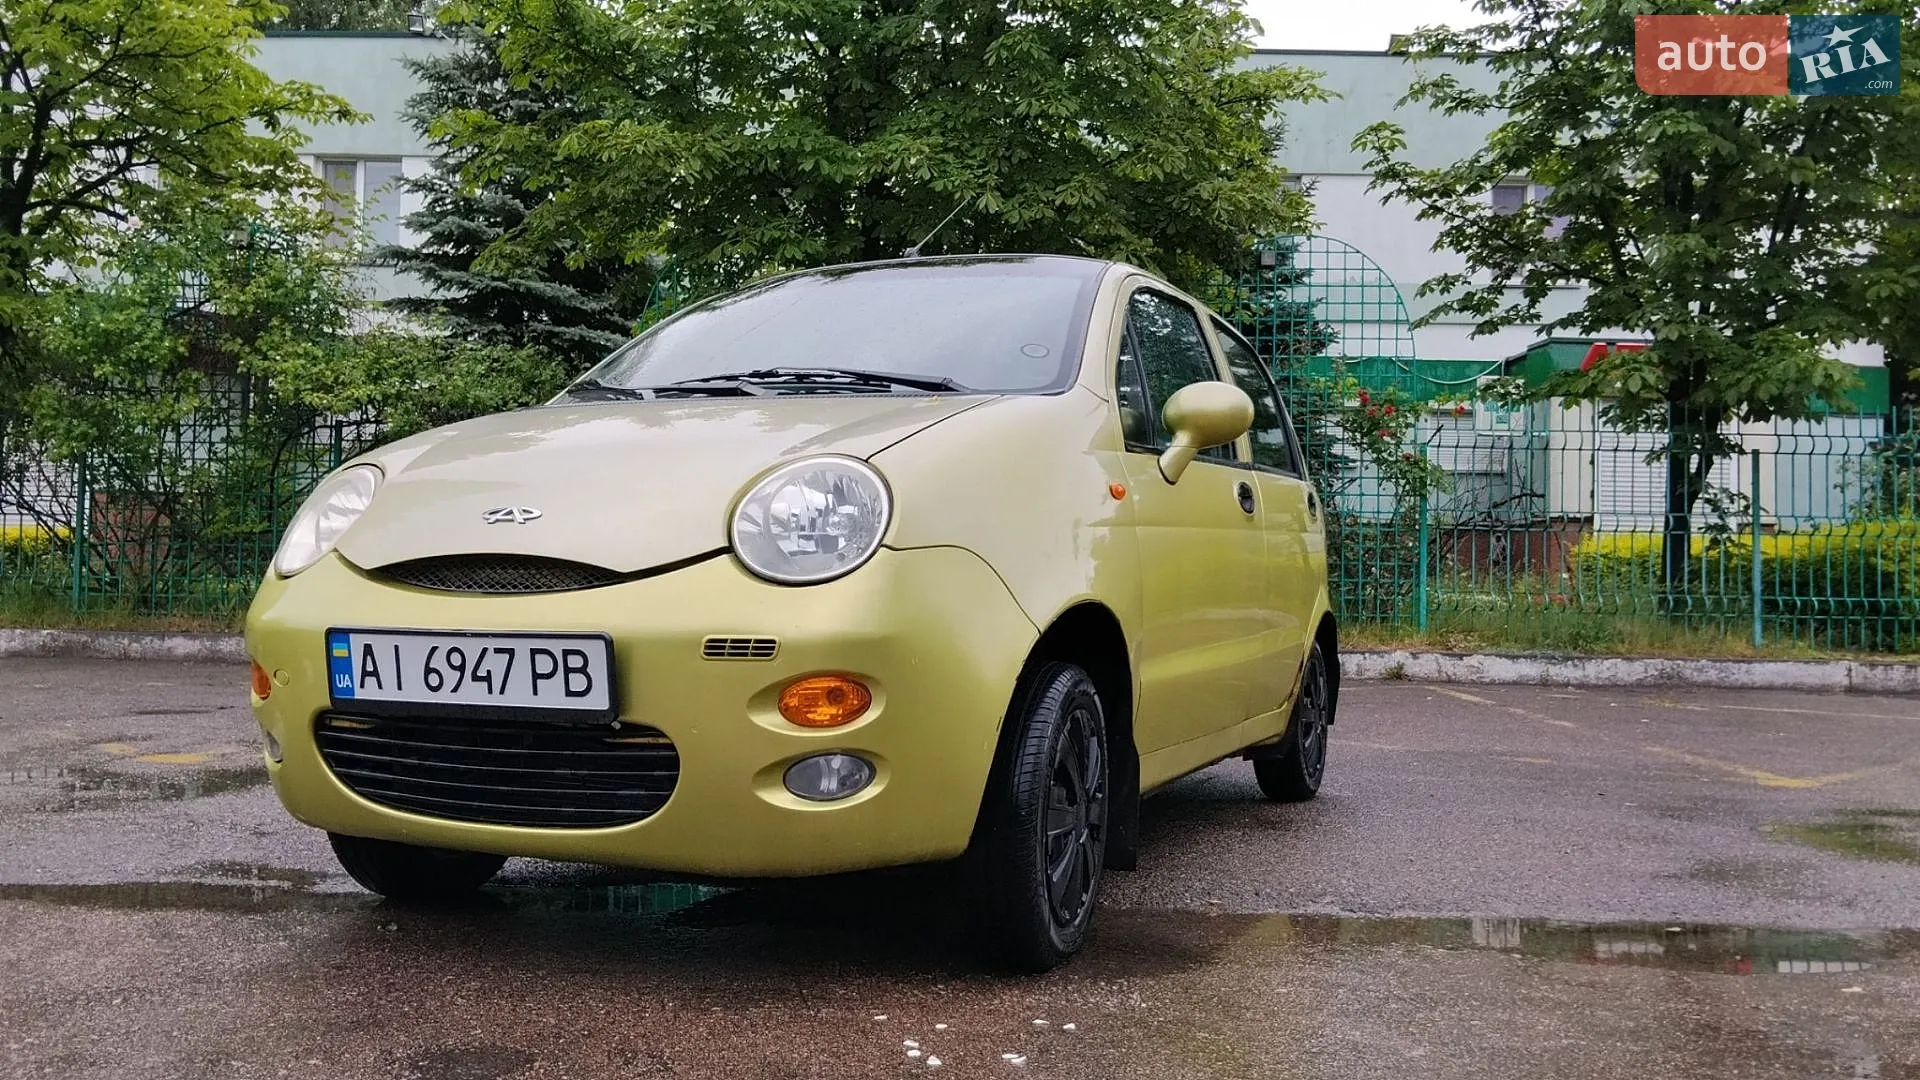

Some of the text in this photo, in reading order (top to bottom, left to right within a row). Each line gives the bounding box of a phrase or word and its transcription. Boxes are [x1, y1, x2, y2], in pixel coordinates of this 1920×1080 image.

[335, 673, 353, 688] UA
[359, 642, 594, 698] AI 6947 PB
